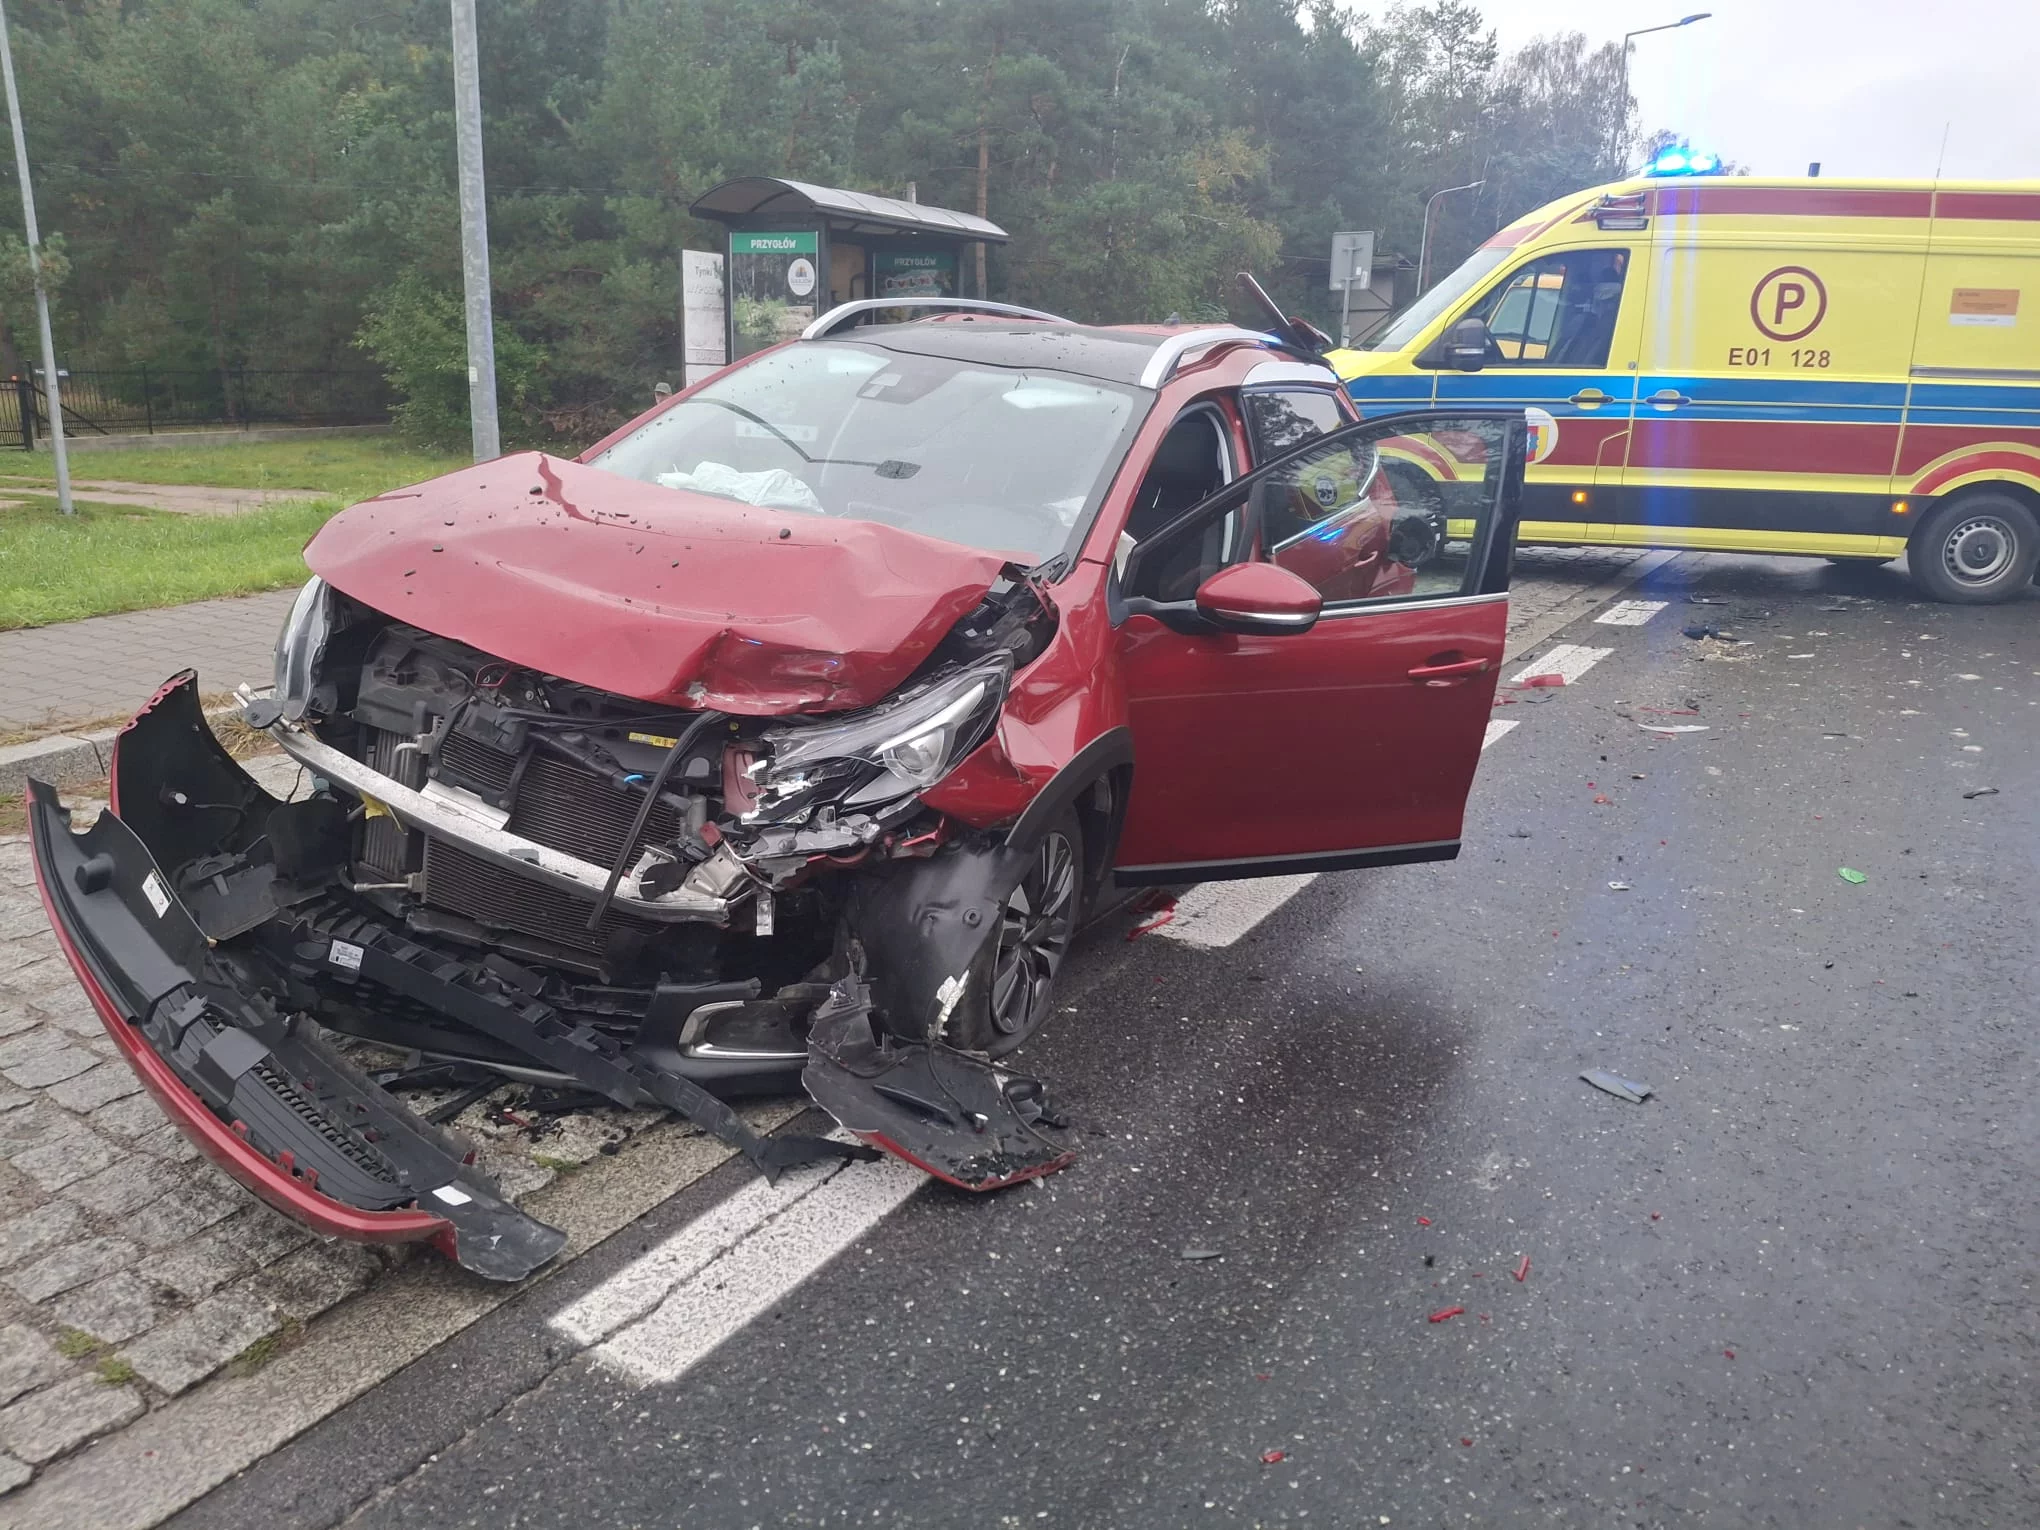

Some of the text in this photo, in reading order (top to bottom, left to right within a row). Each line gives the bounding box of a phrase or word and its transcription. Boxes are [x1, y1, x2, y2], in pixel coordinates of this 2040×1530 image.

[750, 236, 797, 249] PRZYGŁÓW
[1774, 283, 1806, 325] P
[1728, 347, 1831, 369] E01 128
